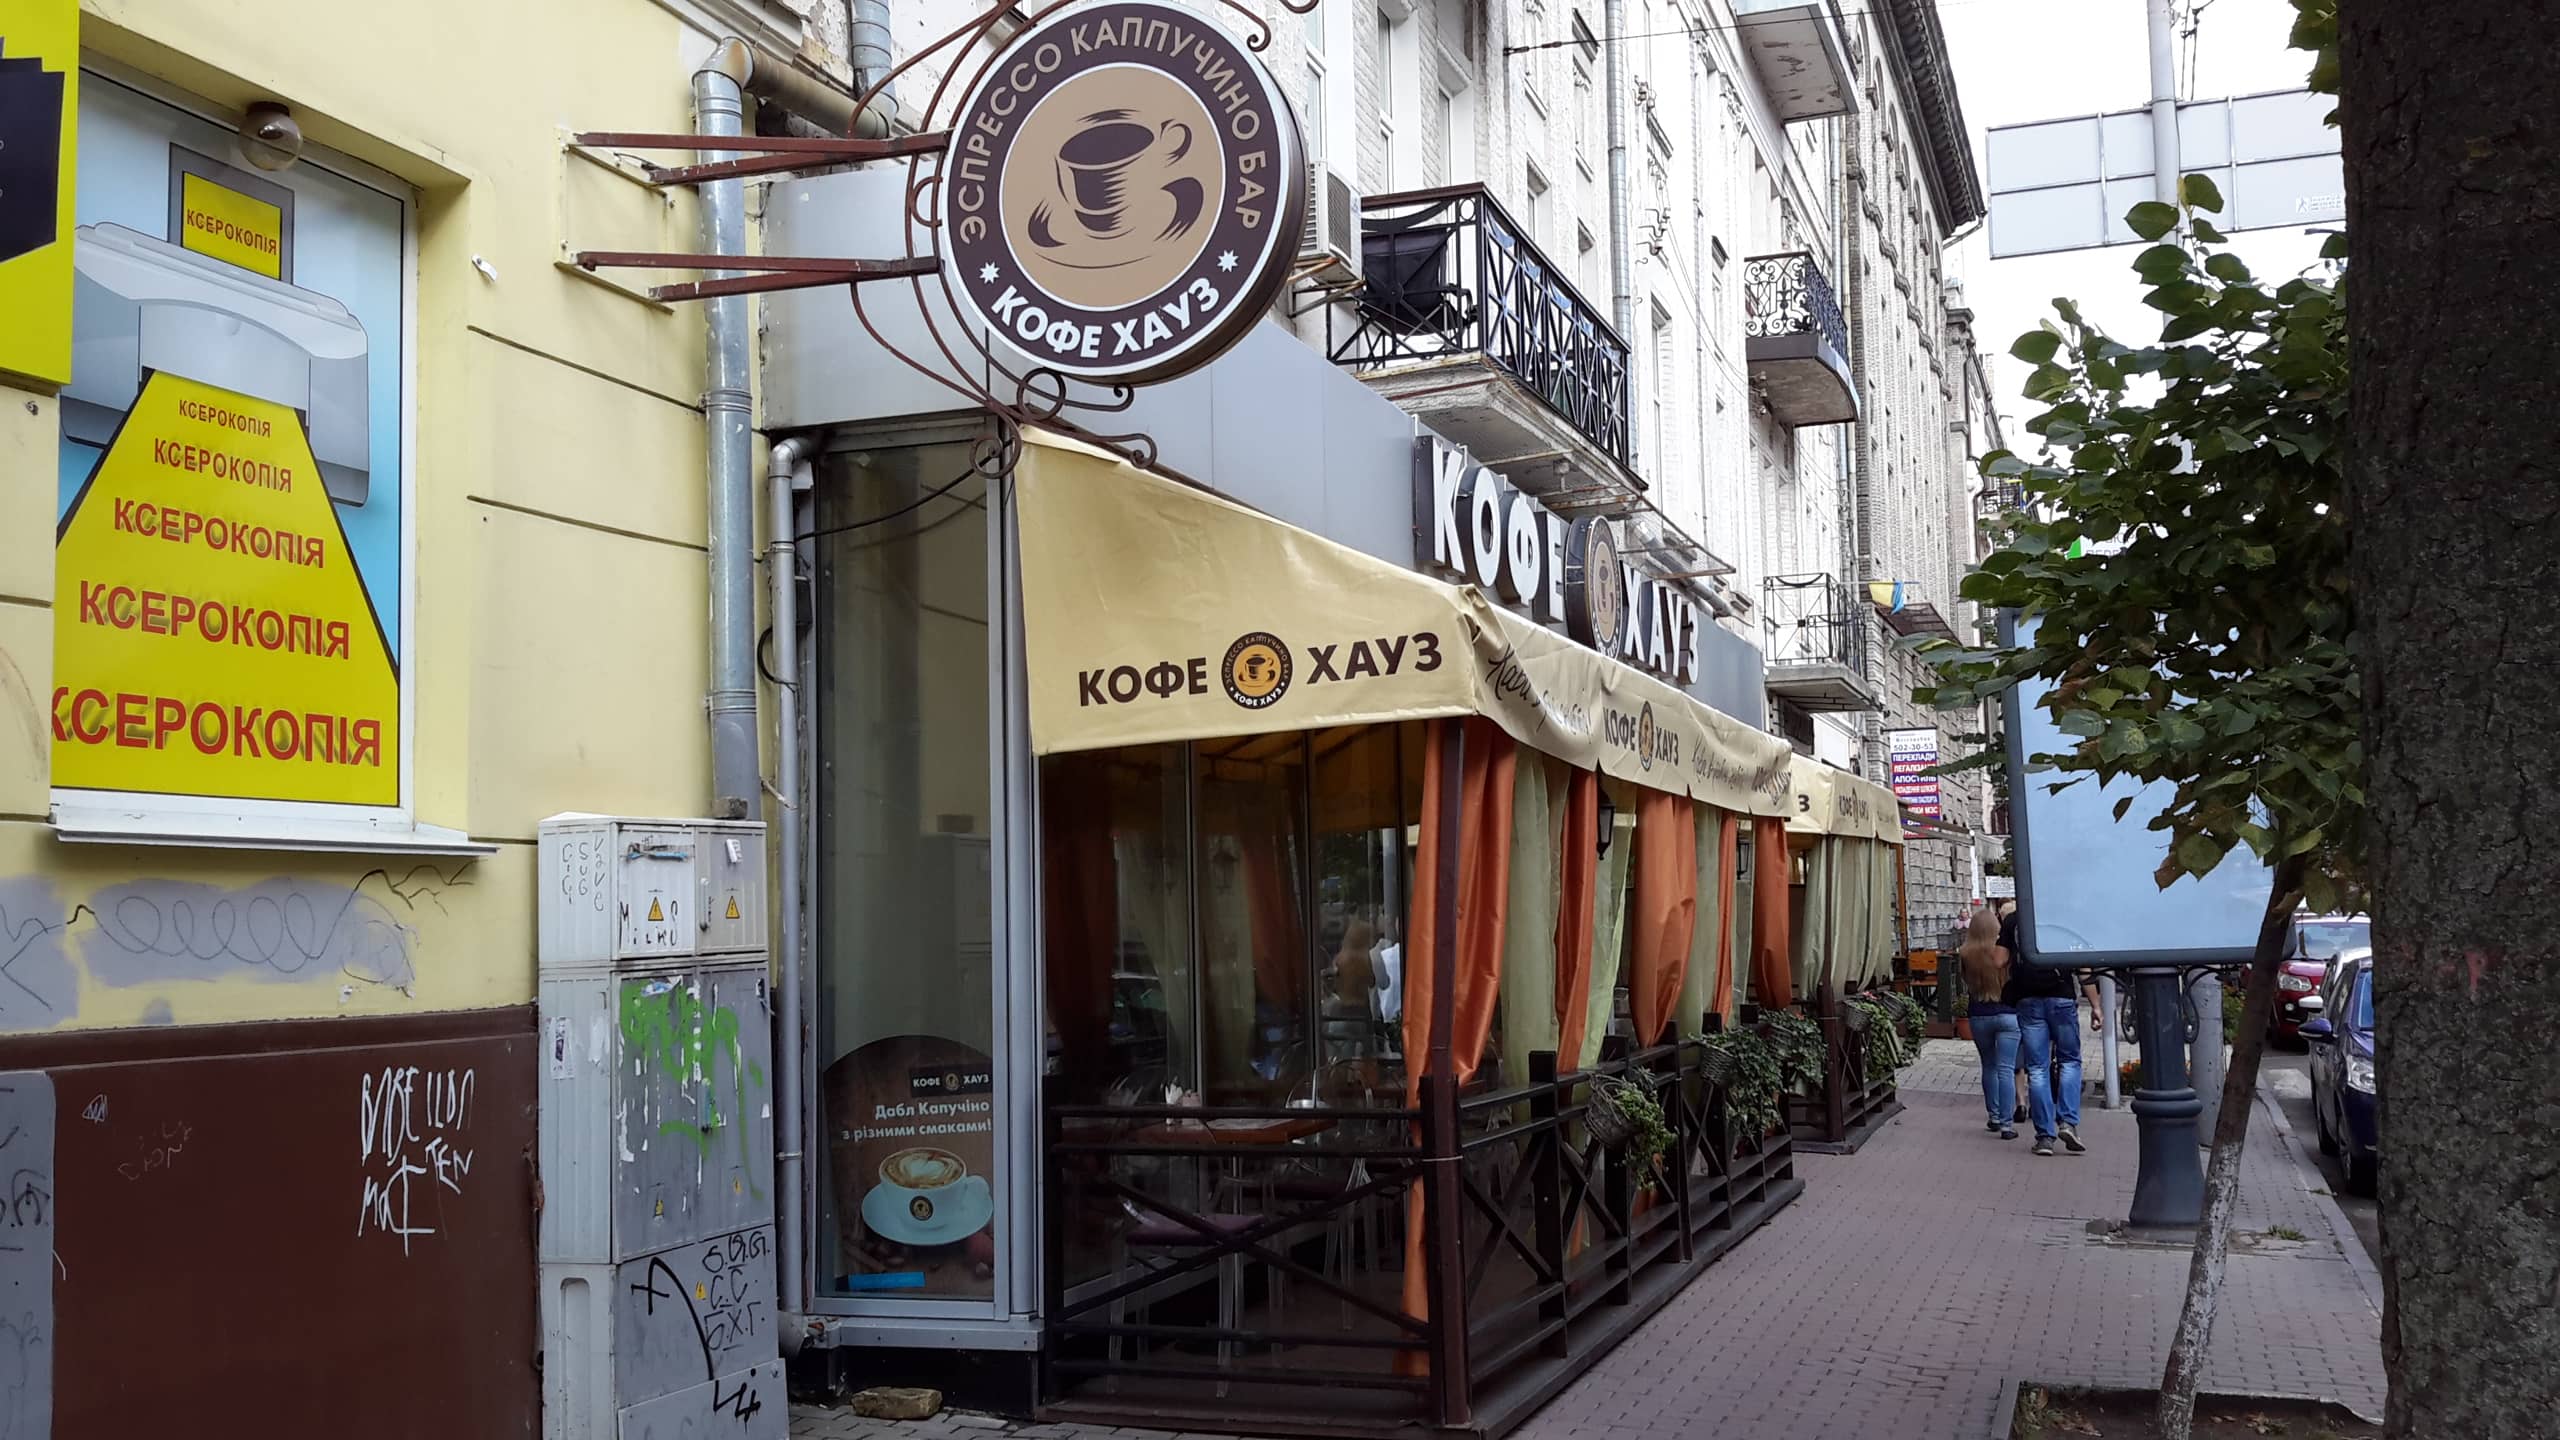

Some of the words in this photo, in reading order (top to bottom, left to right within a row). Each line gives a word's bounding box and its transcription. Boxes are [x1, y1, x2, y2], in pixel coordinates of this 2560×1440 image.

[958, 43, 1062, 245] ЭСПРЕССО
[1069, 16, 1261, 142] КАППУЧИНО
[1234, 150, 1267, 230] БАР
[186, 209, 278, 256] КСЕРОКОПІЯ
[990, 284, 1104, 359] КОФЕ
[1110, 276, 1221, 356] ХАУЗ
[178, 400, 272, 438] КСЕРОКОПІЯ
[154, 438, 293, 493] КСЕРОКОПІЯ
[114, 498, 325, 569] КСЕРОКОПІЯ
[1432, 440, 1564, 624] КОФЕ
[1622, 559, 1700, 684] ХАУЗ
[79, 580, 350, 660] КСЕРОКОПІЯ
[1079, 657, 1208, 707] КОФЕ
[1306, 632, 1443, 685] ХАУЗ
[1260, 687, 1282, 706] ХАУЗ
[1603, 707, 1637, 752] КОФЕ
[1655, 727, 1680, 767] ХАУЗ
[1893, 743, 1934, 752] 502-30-53
[912, 1076, 940, 1087] КОФЕ
[963, 1074, 989, 1084] ХАУЗ
[842, 1131, 850, 1139] з
[854, 1126, 915, 1141] різними
[919, 1119, 992, 1135] смаками!
[875, 1104, 915, 1120] Дабл
[919, 1099, 990, 1117] Капучіно
